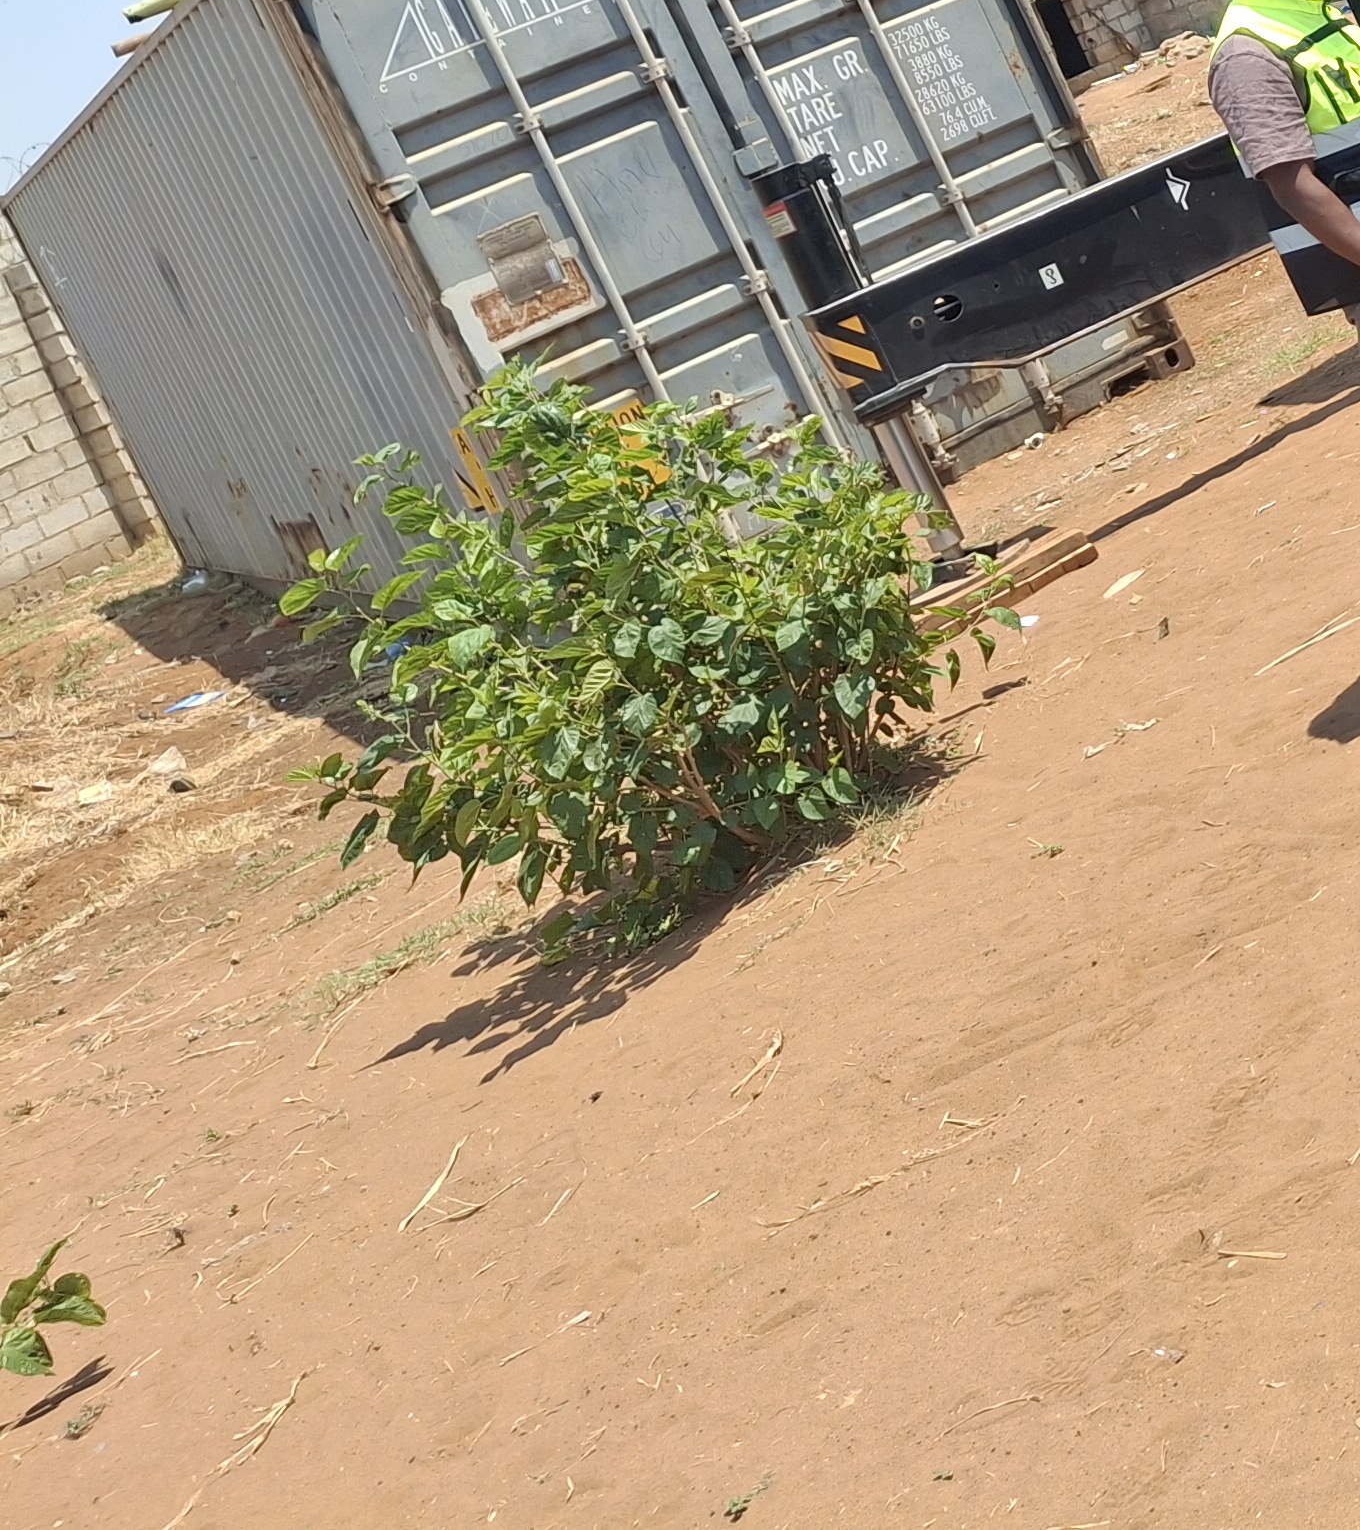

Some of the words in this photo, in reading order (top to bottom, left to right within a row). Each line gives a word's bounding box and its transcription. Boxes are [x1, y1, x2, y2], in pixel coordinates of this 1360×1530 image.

[888, 23, 923, 46] 32500
[923, 16, 939, 32] KG
[894, 36, 929, 59] 71650
[929, 27, 950, 45] LBS
[908, 51, 937, 71] 3880
[936, 44, 952, 60] KG
[914, 64, 943, 84] 8550
[942, 55, 963, 72] LBS
[772, 65, 829, 106] MAX.
[832, 49, 869, 81] GR.
[915, 78, 950, 102] 28620
[949, 72, 965, 88] KG
[787, 91, 843, 134] TARE
[922, 91, 956, 115] 63100
[955, 83, 976, 100] LBS
[939, 106, 963, 126] 76.4
[940, 119, 969, 141] 2698
